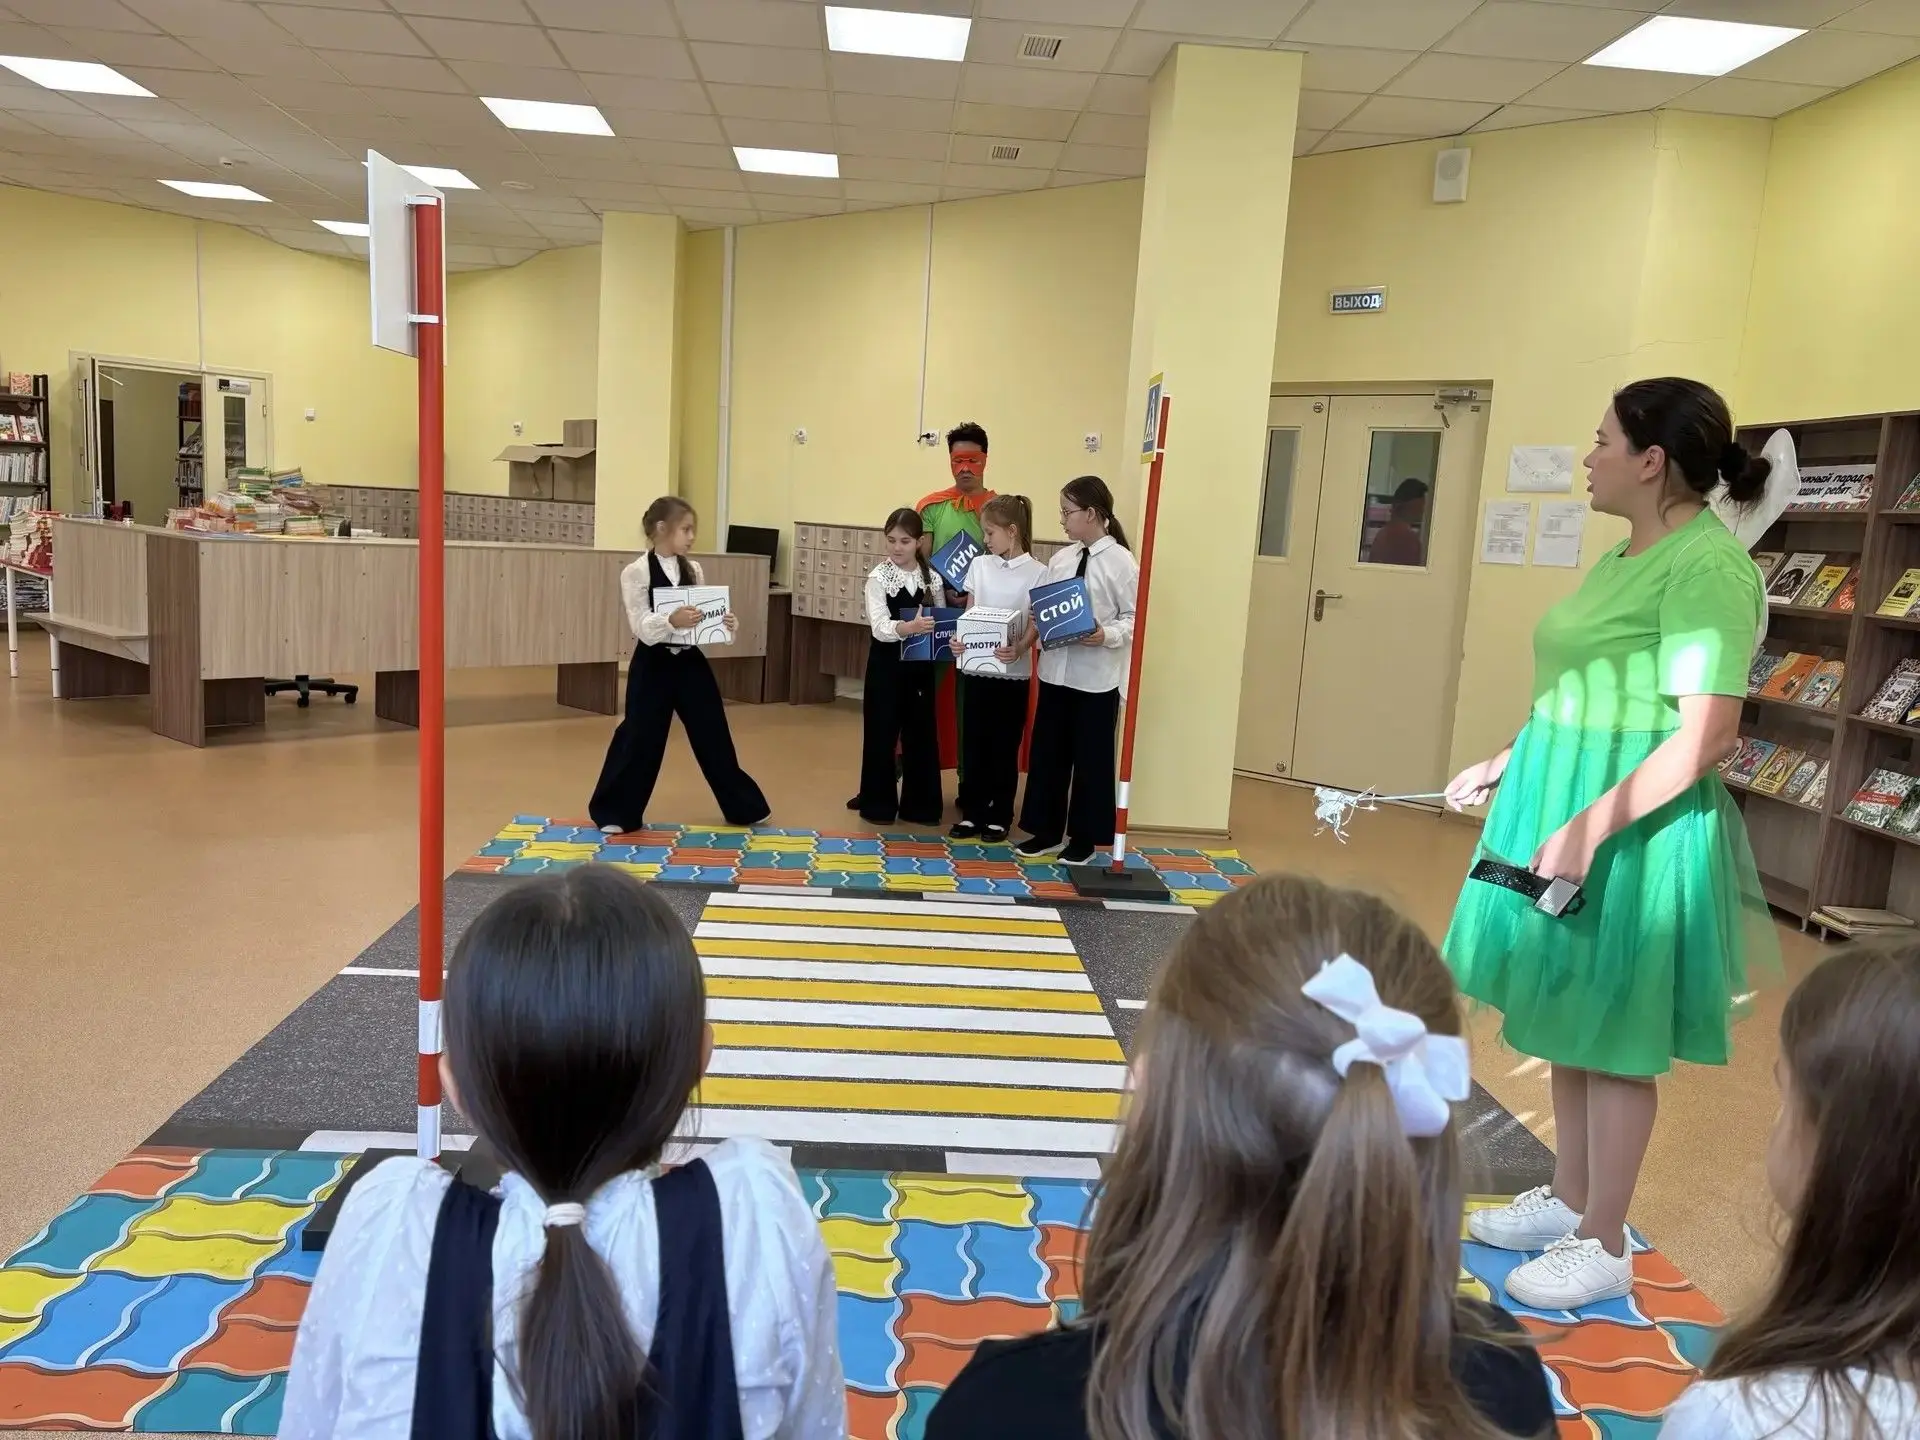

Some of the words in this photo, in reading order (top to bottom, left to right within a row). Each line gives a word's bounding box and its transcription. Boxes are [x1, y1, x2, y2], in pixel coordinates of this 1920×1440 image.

[1335, 295, 1381, 309] ВЫХОД
[947, 543, 979, 579] ИДИ
[700, 605, 727, 623] УМАЙ
[1039, 592, 1084, 622] СТОЙ
[964, 641, 1002, 650] СМОТРИ
